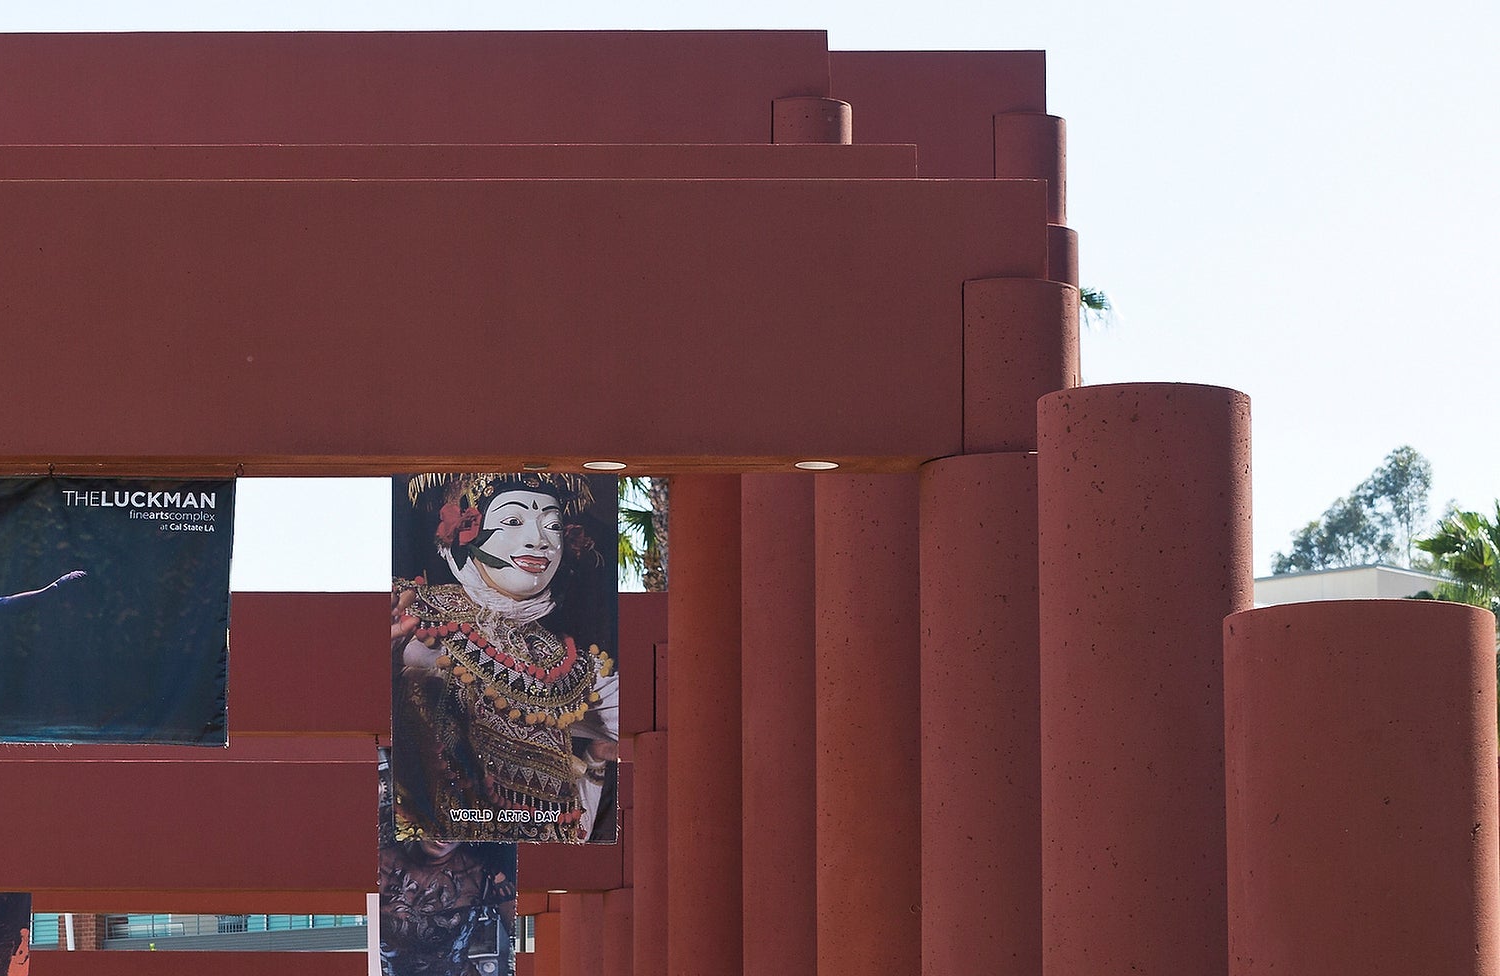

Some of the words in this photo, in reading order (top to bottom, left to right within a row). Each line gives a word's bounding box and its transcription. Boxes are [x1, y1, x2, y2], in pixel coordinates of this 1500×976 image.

[62, 490, 216, 509] THELUCKMAN
[129, 509, 216, 523] fineartscomplex
[159, 523, 168, 532] at
[169, 522, 182, 532] Cal
[183, 522, 203, 533] State
[204, 524, 215, 533] LA
[449, 809, 494, 823] WORLD
[496, 809, 531, 823] ARTS
[534, 810, 561, 823] DAY
